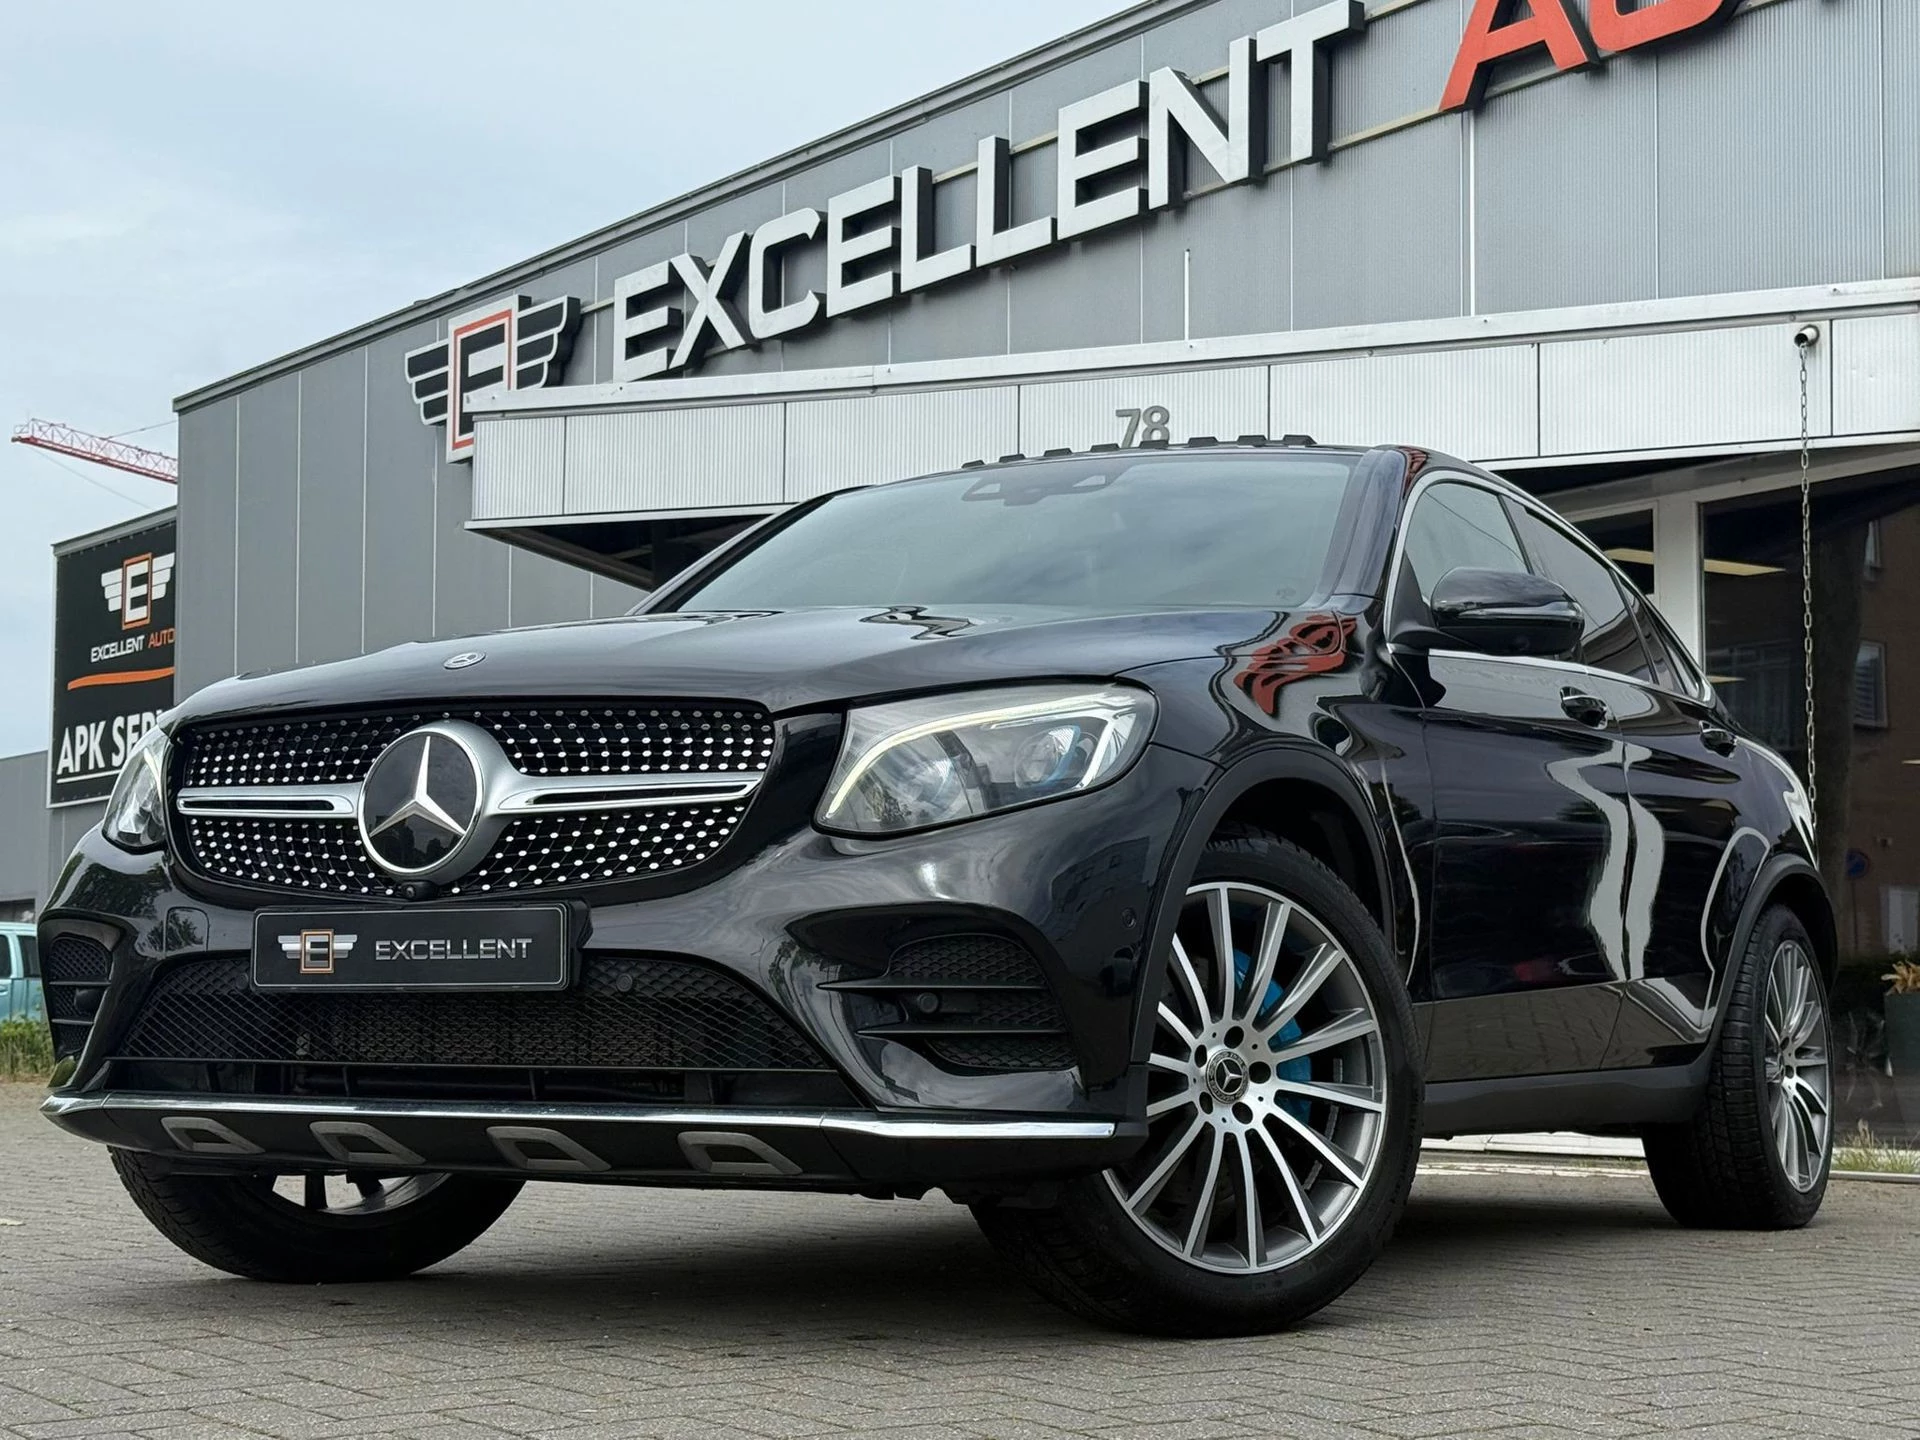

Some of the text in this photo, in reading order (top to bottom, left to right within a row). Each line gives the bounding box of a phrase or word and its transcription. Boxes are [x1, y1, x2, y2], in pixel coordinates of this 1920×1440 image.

[612, 0, 1738, 383] EXCELLENT A
[1115, 405, 1170, 448] 78
[91, 627, 175, 662] EXCELLENT AUTO
[56, 709, 163, 775] APK SE
[375, 938, 532, 960] EXCELLENT
